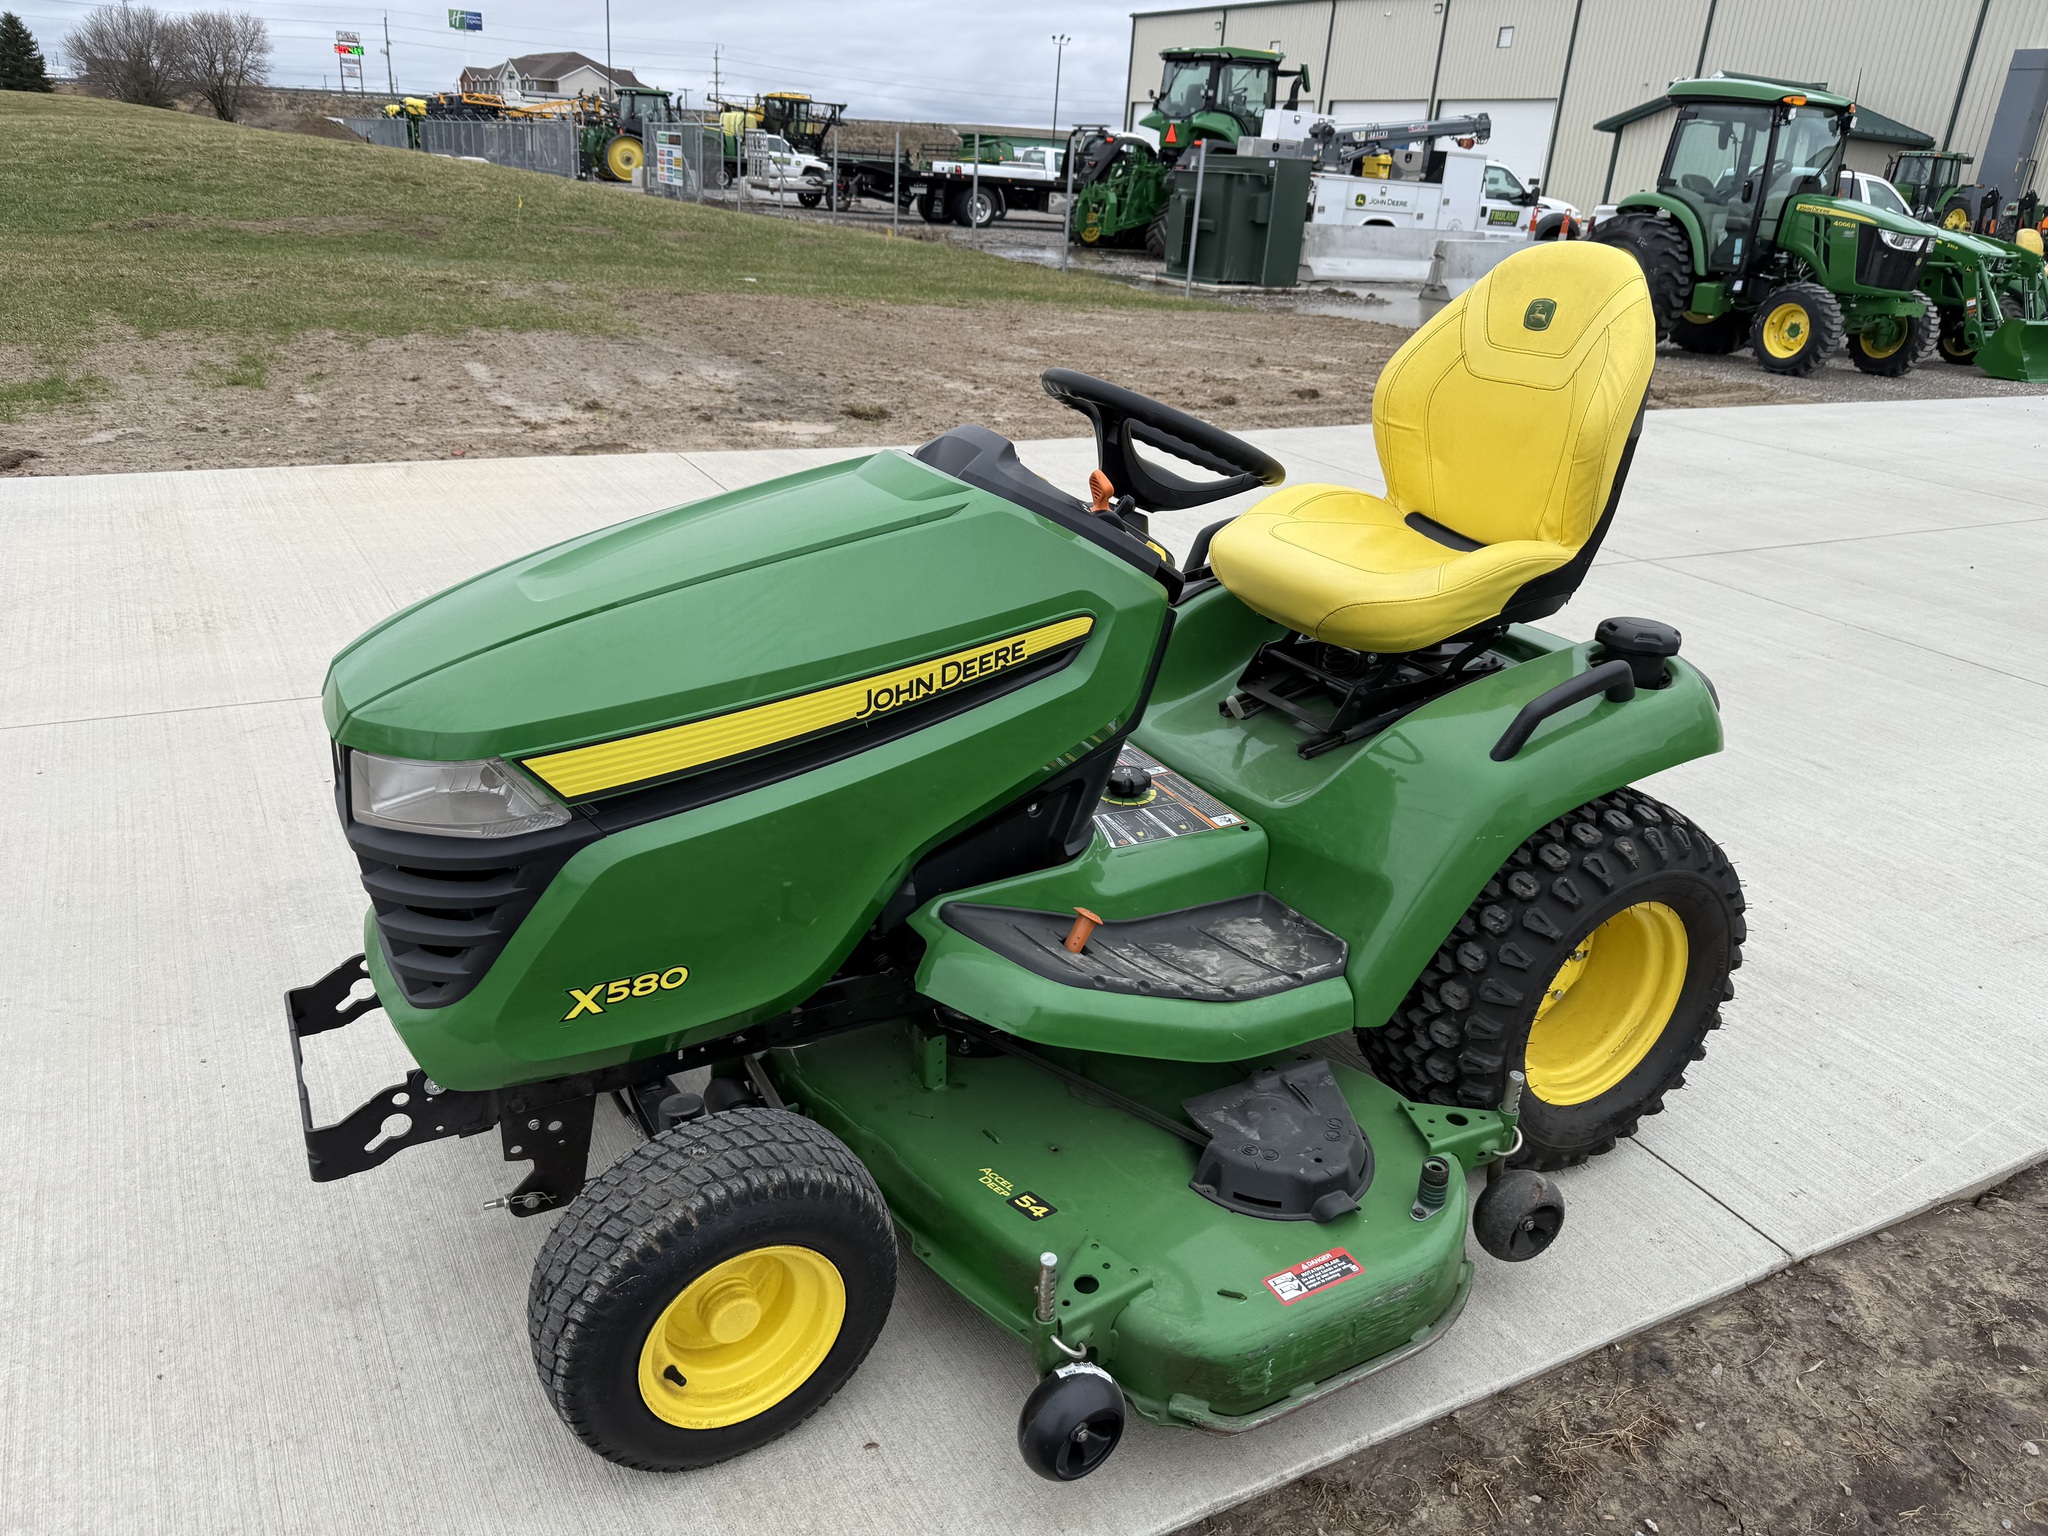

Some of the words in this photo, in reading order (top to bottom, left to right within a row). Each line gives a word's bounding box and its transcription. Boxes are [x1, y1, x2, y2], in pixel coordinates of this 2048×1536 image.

[1387, 198, 1408, 207] DEERE
[1833, 220, 1857, 229] 4066R
[855, 672, 934, 719] JOHN
[940, 639, 1027, 689] DEERE
[560, 966, 690, 1021] X580
[978, 1176, 1011, 1197] DEEP
[979, 1167, 1014, 1191] ACCEL
[1014, 1194, 1049, 1218] 54
[1306, 1253, 1332, 1267] DANGER
